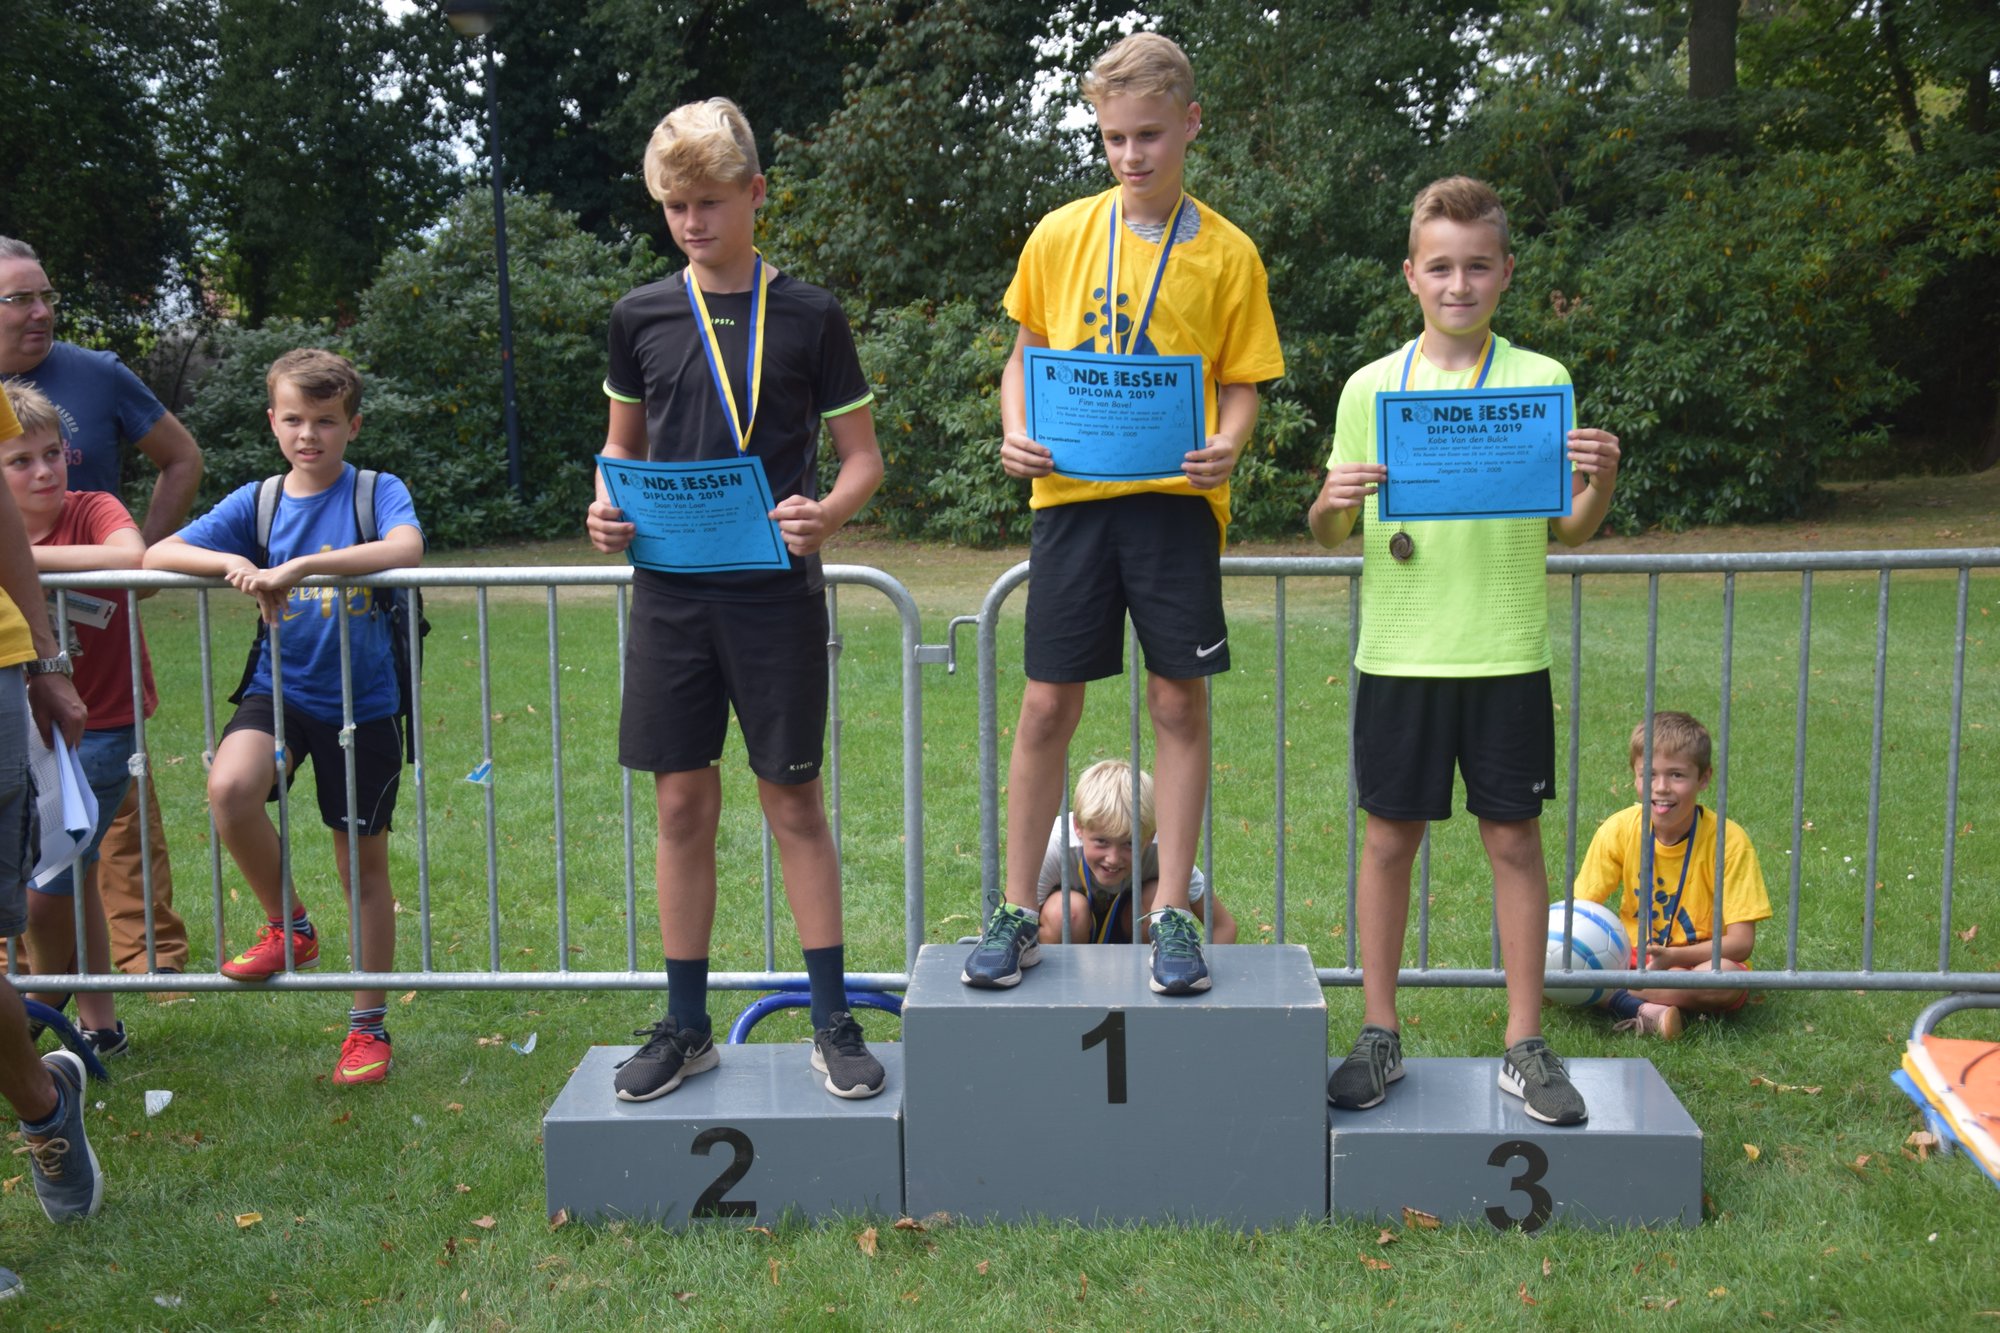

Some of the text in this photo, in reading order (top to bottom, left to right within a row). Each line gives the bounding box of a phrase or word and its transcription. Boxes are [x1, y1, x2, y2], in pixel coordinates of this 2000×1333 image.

[711, 318, 735, 326] IPSTA
[1120, 371, 1177, 388] ESSEN
[1068, 386, 1155, 399] DIPLOMA 2019
[1486, 402, 1546, 421] ESSEN
[1427, 423, 1522, 435] DIPLOMA 2019
[686, 473, 742, 490] ESSEN
[643, 490, 724, 501] DIPLOMA 2019
[1082, 1011, 1127, 1104] 1
[690, 1127, 757, 1218] 2
[1485, 1140, 1553, 1231] 3
